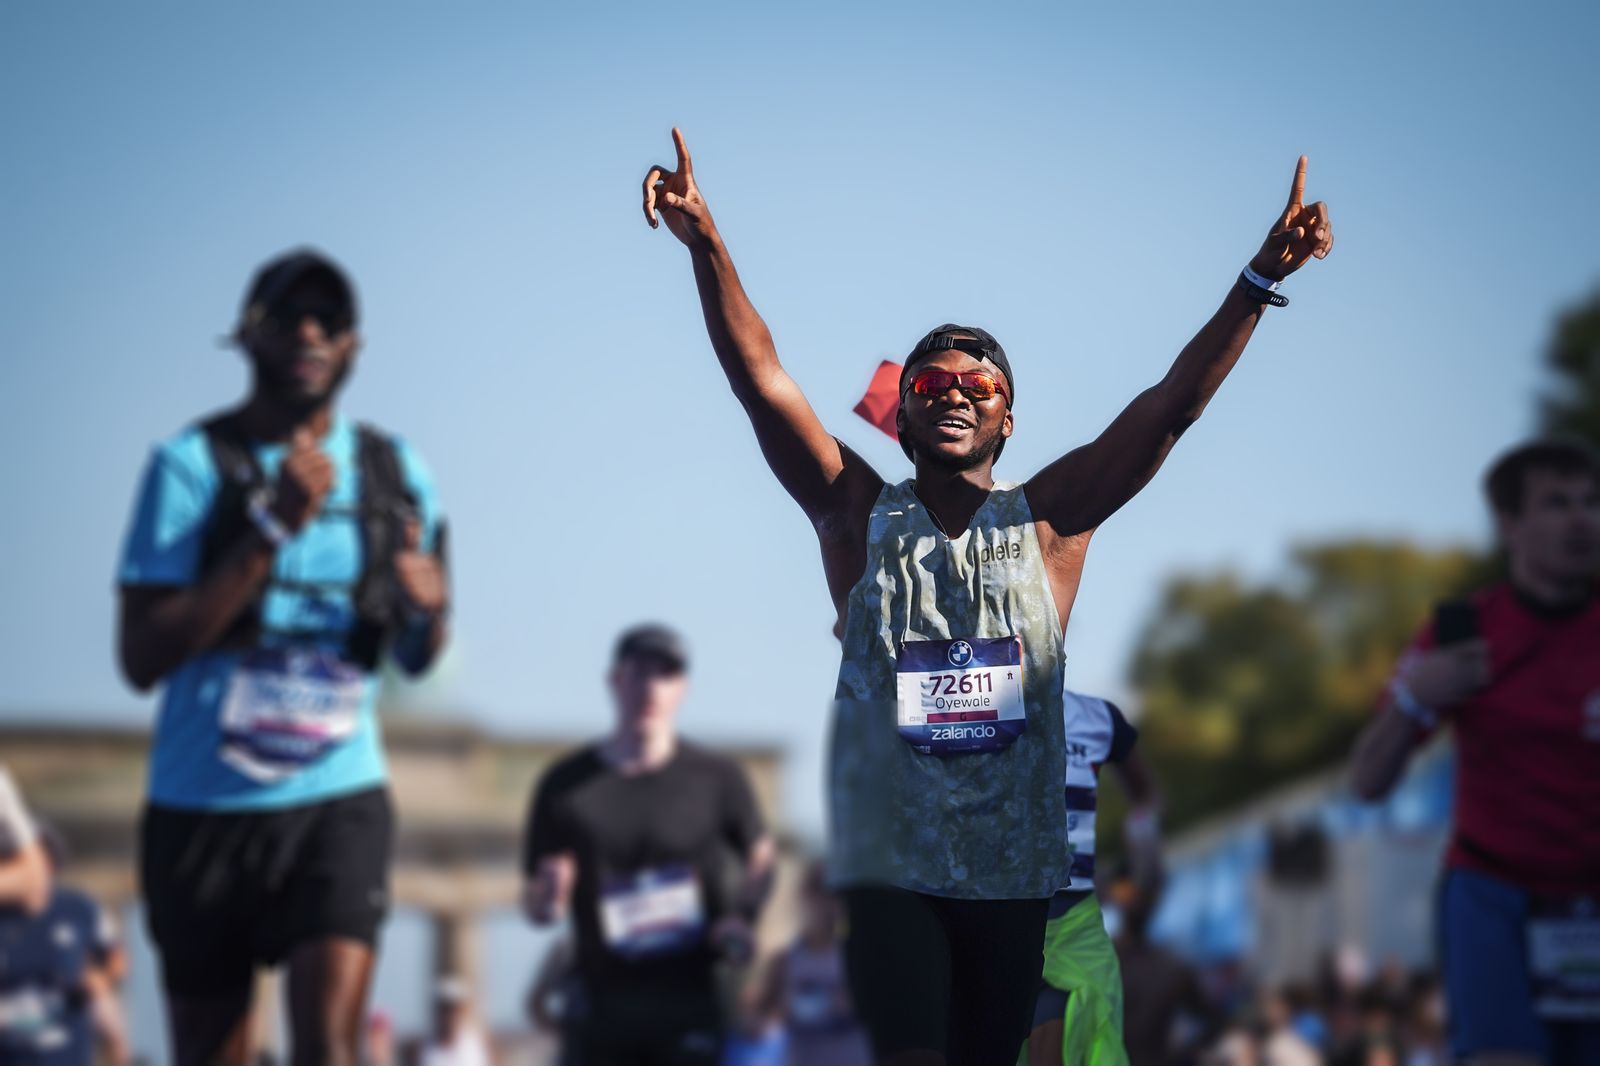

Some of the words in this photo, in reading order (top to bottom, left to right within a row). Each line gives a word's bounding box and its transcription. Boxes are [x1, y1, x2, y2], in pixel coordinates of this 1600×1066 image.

[929, 672, 993, 696] 72611
[935, 696, 991, 711] Oyewale
[931, 725, 996, 741] zalando
